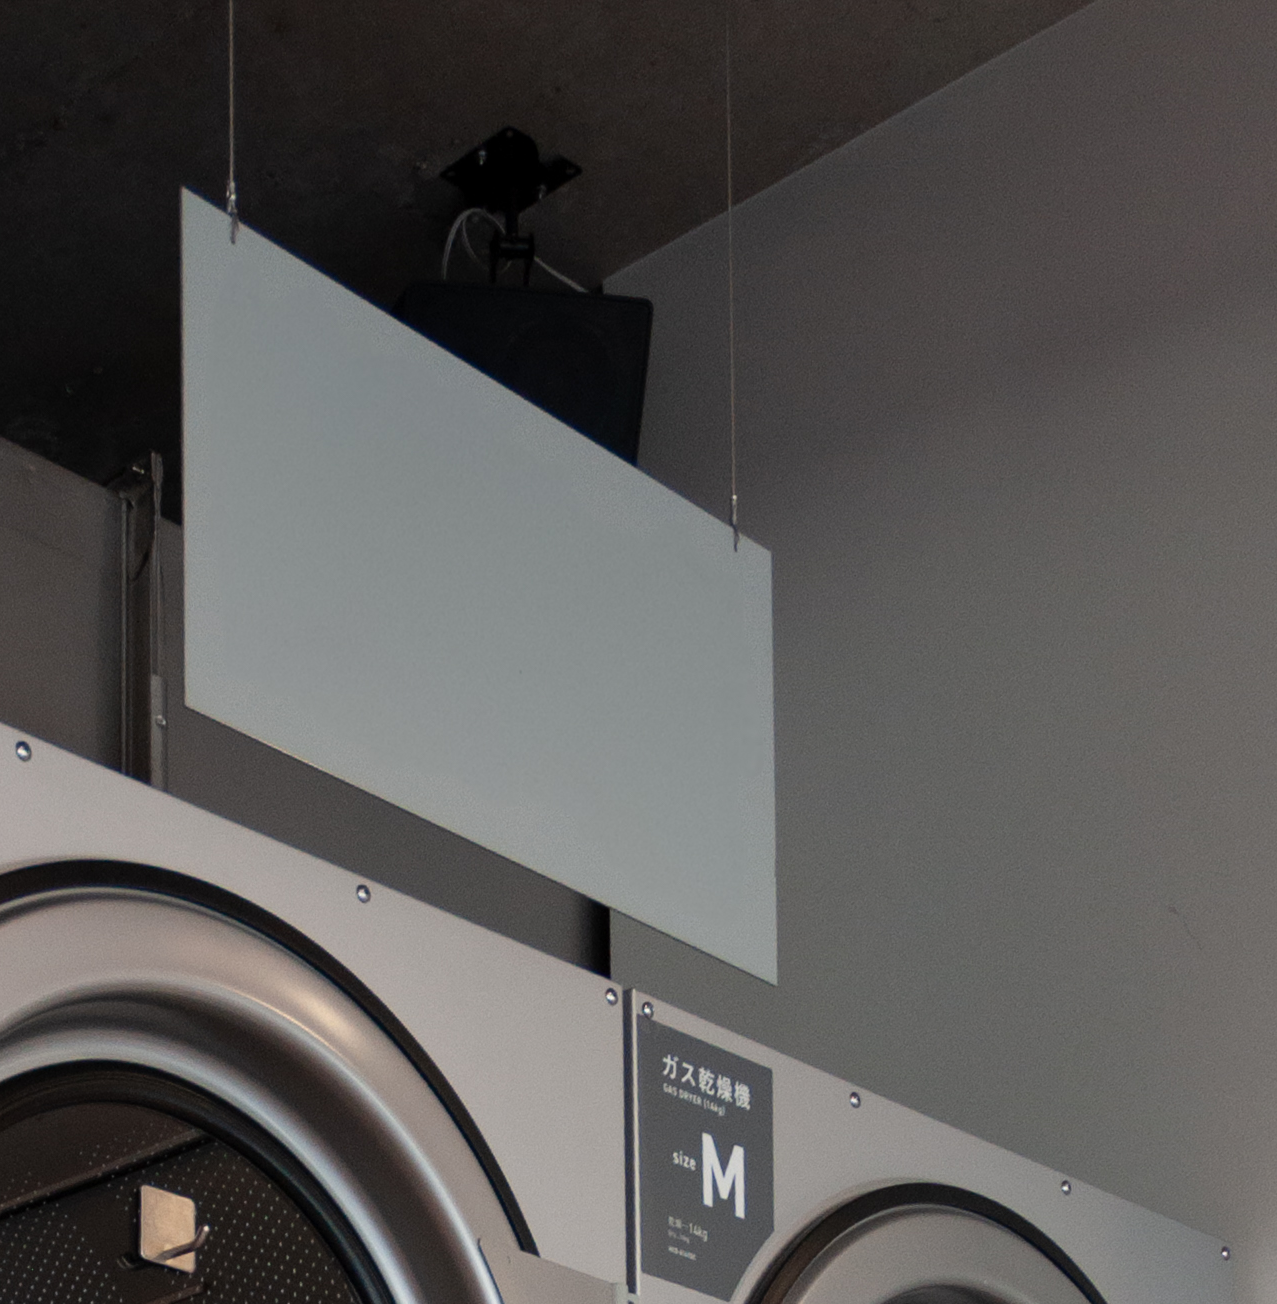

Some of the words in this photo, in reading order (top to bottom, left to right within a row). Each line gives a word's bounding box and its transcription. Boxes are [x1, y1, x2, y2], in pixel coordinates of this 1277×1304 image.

[663, 1054, 750, 1111] ガス乾燥機
[663, 1082, 677, 1097] GAS
[678, 1089, 702, 1106] DRYER
[673, 1150, 696, 1171] size
[701, 1131, 745, 1219] M
